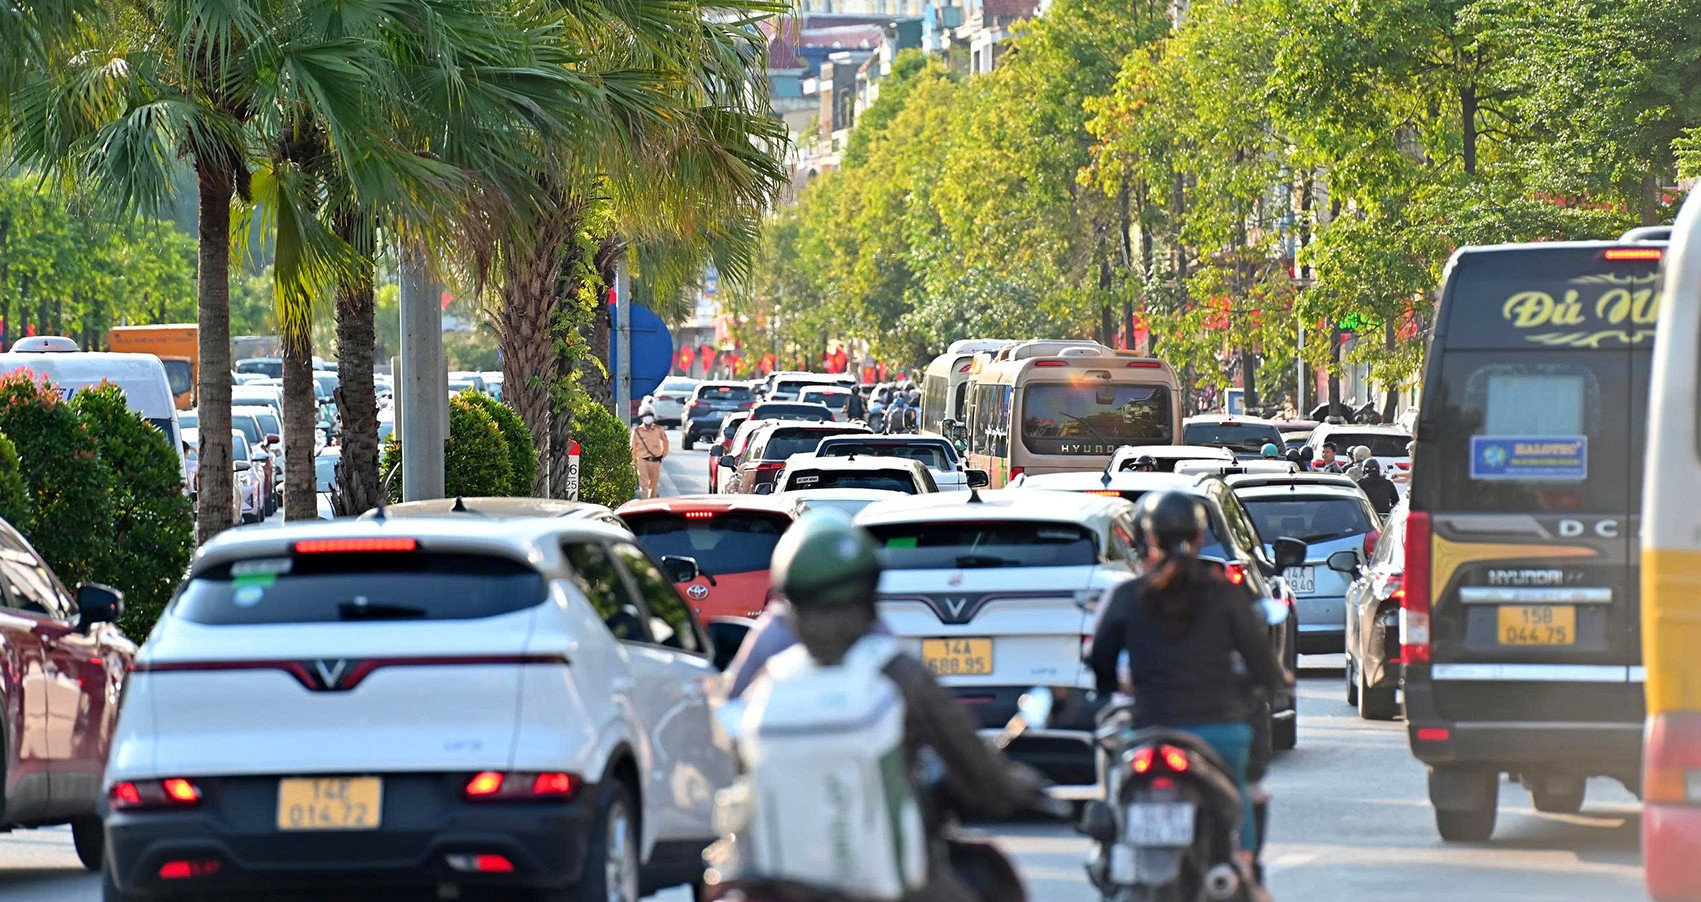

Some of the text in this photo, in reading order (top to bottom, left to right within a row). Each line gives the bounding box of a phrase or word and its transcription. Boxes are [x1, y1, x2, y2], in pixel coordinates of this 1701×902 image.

[1061, 445, 1115, 453] HYUND
[1559, 519, 1619, 537] DC
[1488, 569, 1563, 585] HYUNDAI
[1523, 608, 1553, 624] 15B
[1506, 626, 1567, 643] 044.75
[944, 641, 972, 655] 14A
